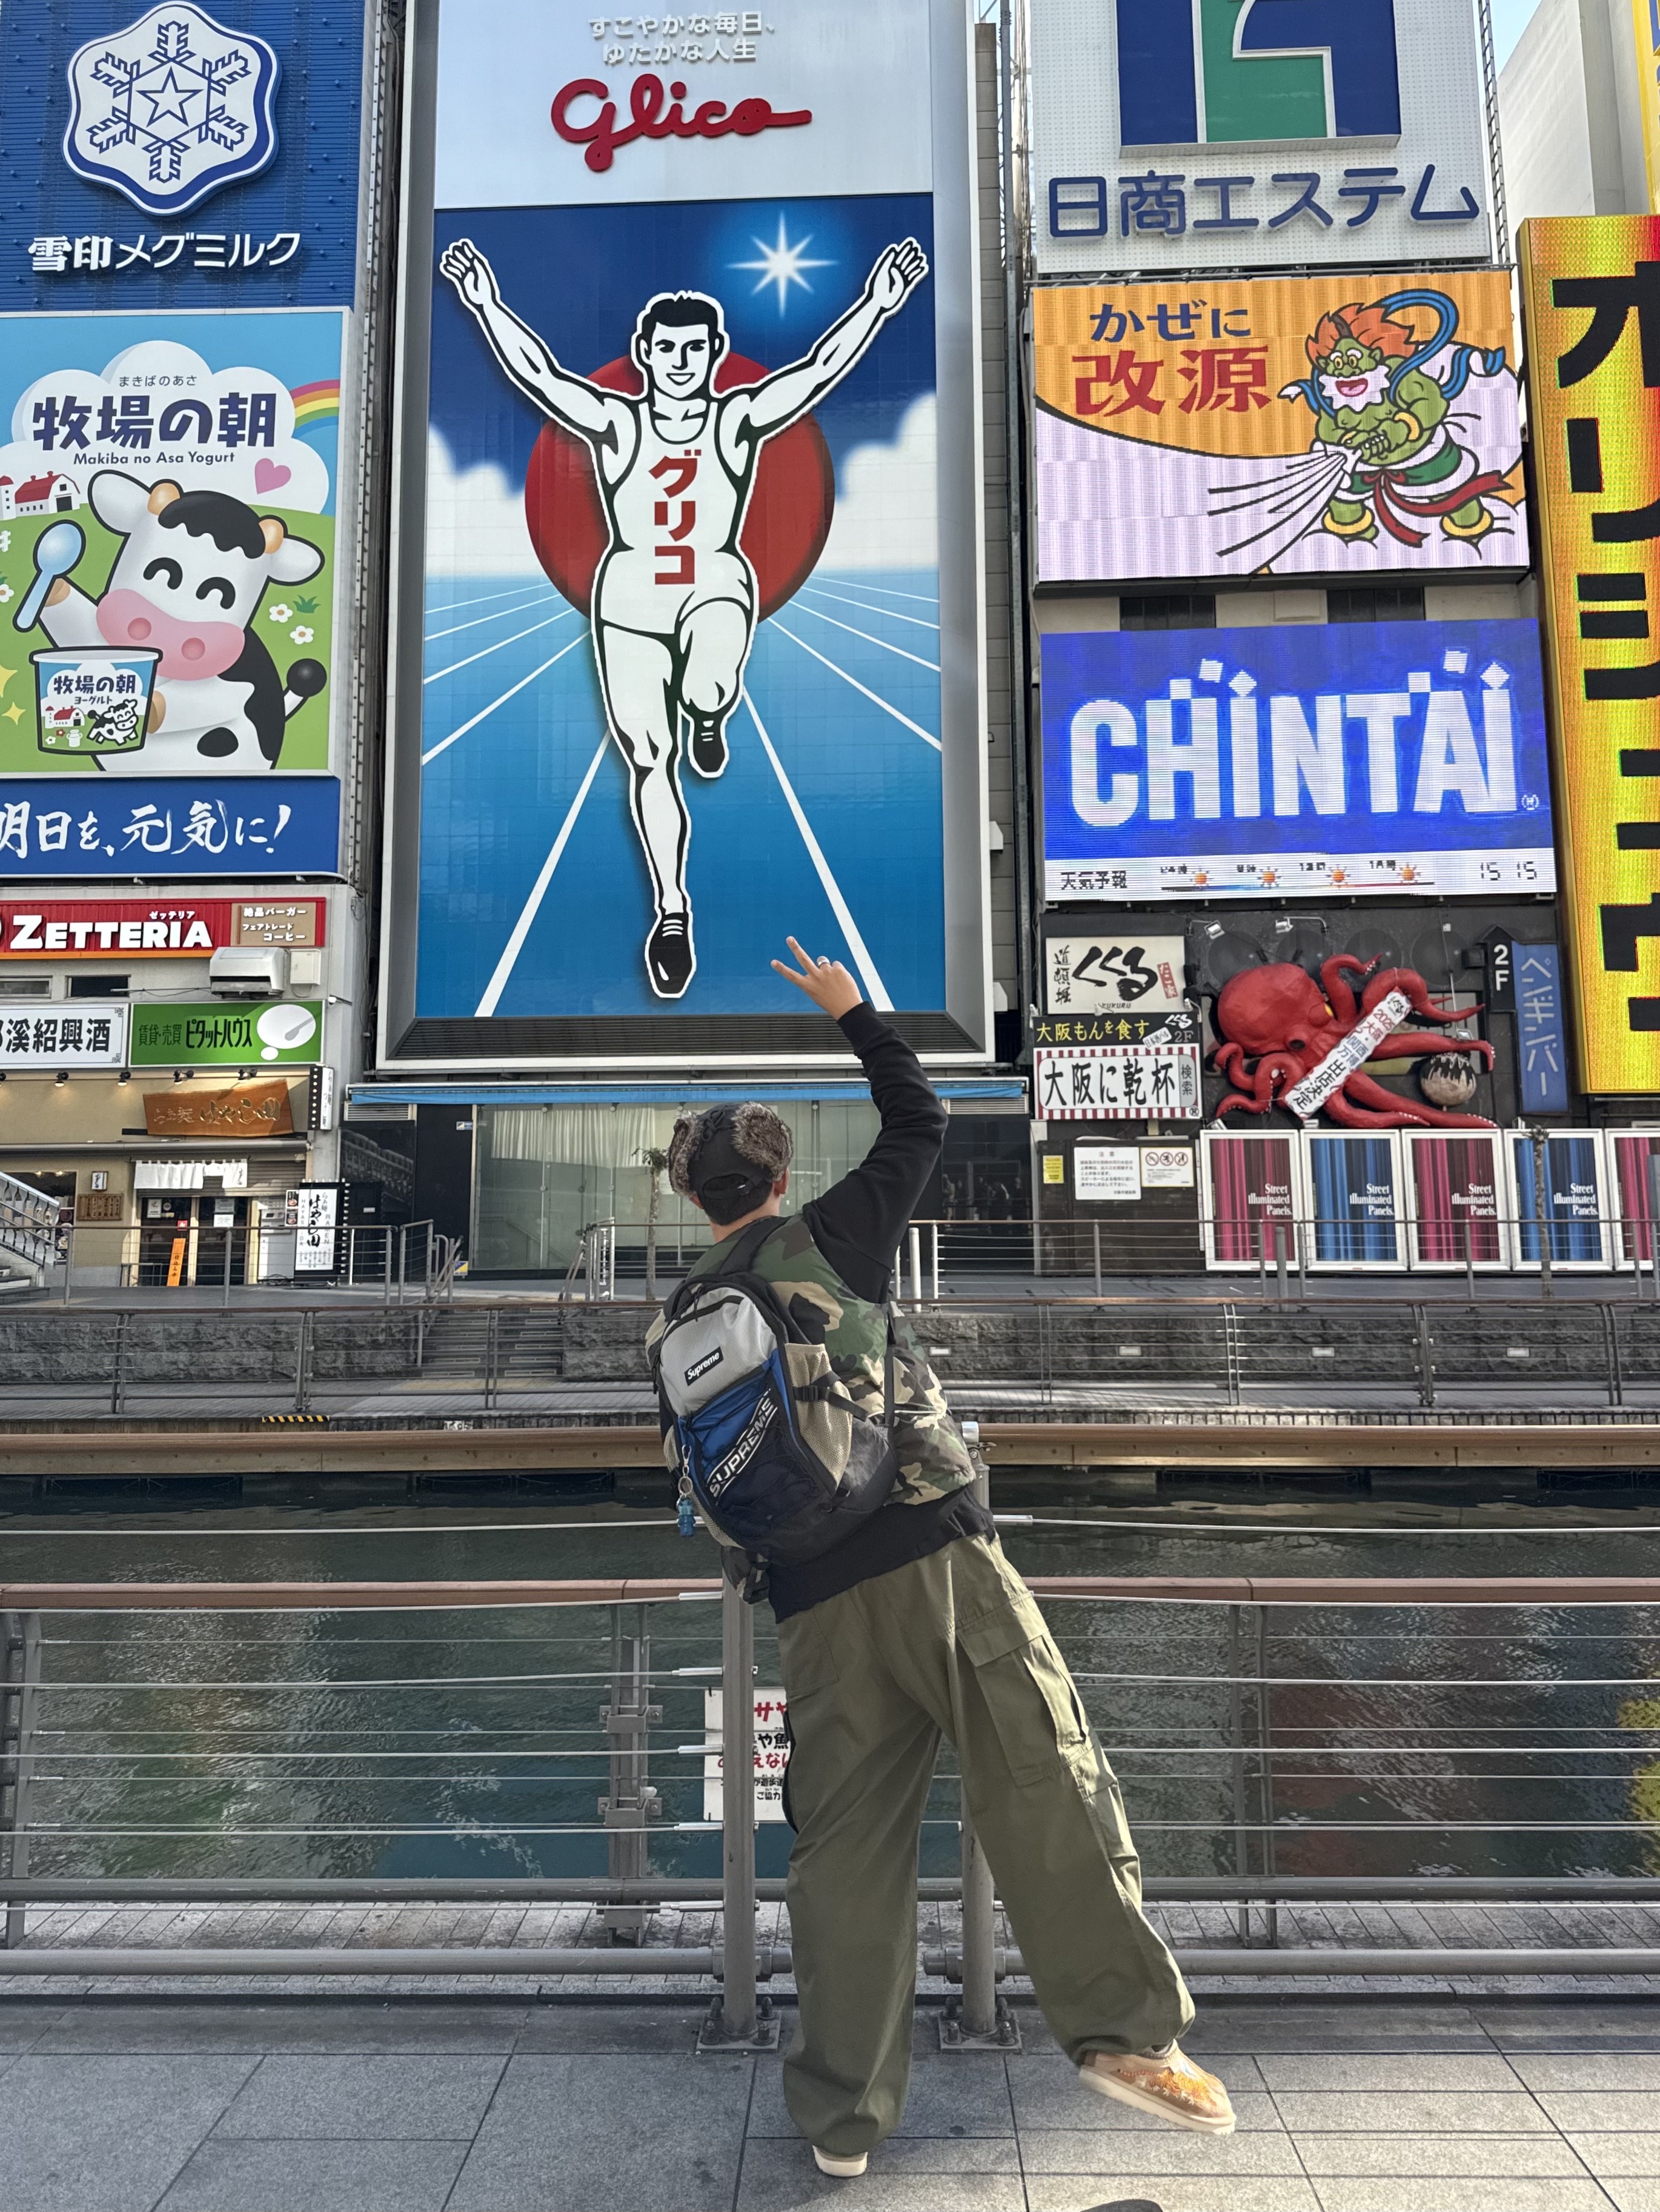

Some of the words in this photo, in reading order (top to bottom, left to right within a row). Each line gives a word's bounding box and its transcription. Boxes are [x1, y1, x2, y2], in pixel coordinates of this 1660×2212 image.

[588, 10, 775, 39] すこやかな毎日、
[602, 38, 757, 65] ゆたかな人生
[550, 73, 812, 172] Glico
[1048, 164, 1480, 239] 日商エステム
[28, 231, 300, 272] 雪印メグミルク
[1090, 299, 1252, 344] かぜに
[118, 374, 198, 387] まきばのあさ
[1072, 345, 1272, 418] 改源
[32, 393, 277, 451] 牧場の朝
[73, 451, 130, 465] Makiba
[133, 455, 151, 465] no
[156, 452, 184, 465] Asa
[188, 451, 235, 467] Yogurt
[648, 449, 702, 585] グリコ
[53, 674, 136, 694] 牧場の朝
[73, 694, 113, 706] ヨーグルト
[1060, 870, 1127, 891] 天気予報
[149, 911, 195, 920] ゼッテリア
[244, 907, 307, 917] 絶品バーガー
[10, 914, 213, 949] ZETTERIA
[242, 923, 294, 931] フェアトレード
[263, 932, 306, 942] コーヒー
[1053, 945, 1071, 1005] 道頓堀
[1072, 946, 1158, 1001] くくる
[1494, 943, 1509, 991] 2F
[185, 1018, 253, 1049] ピタットハウス
[1036, 1018, 1150, 1043] 大阪もんを食す
[1373, 1009, 1395, 1031] 2025
[1521, 957, 1559, 1096] ペンギンバー
[0, 1018, 111, 1053] 溪紹興酒
[1174, 1031, 1194, 1043] 2F
[1044, 1057, 1175, 1107] 大阪に乾杯
[1181, 1064, 1193, 1095] 検索
[1292, 1059, 1346, 1110] 出店決定
[1264, 1183, 1288, 1194] Street
[1366, 1183, 1389, 1194] Street
[1468, 1183, 1492, 1194] Street
[1570, 1183, 1594, 1194] Street
[686, 1351, 720, 1381] Supreme
